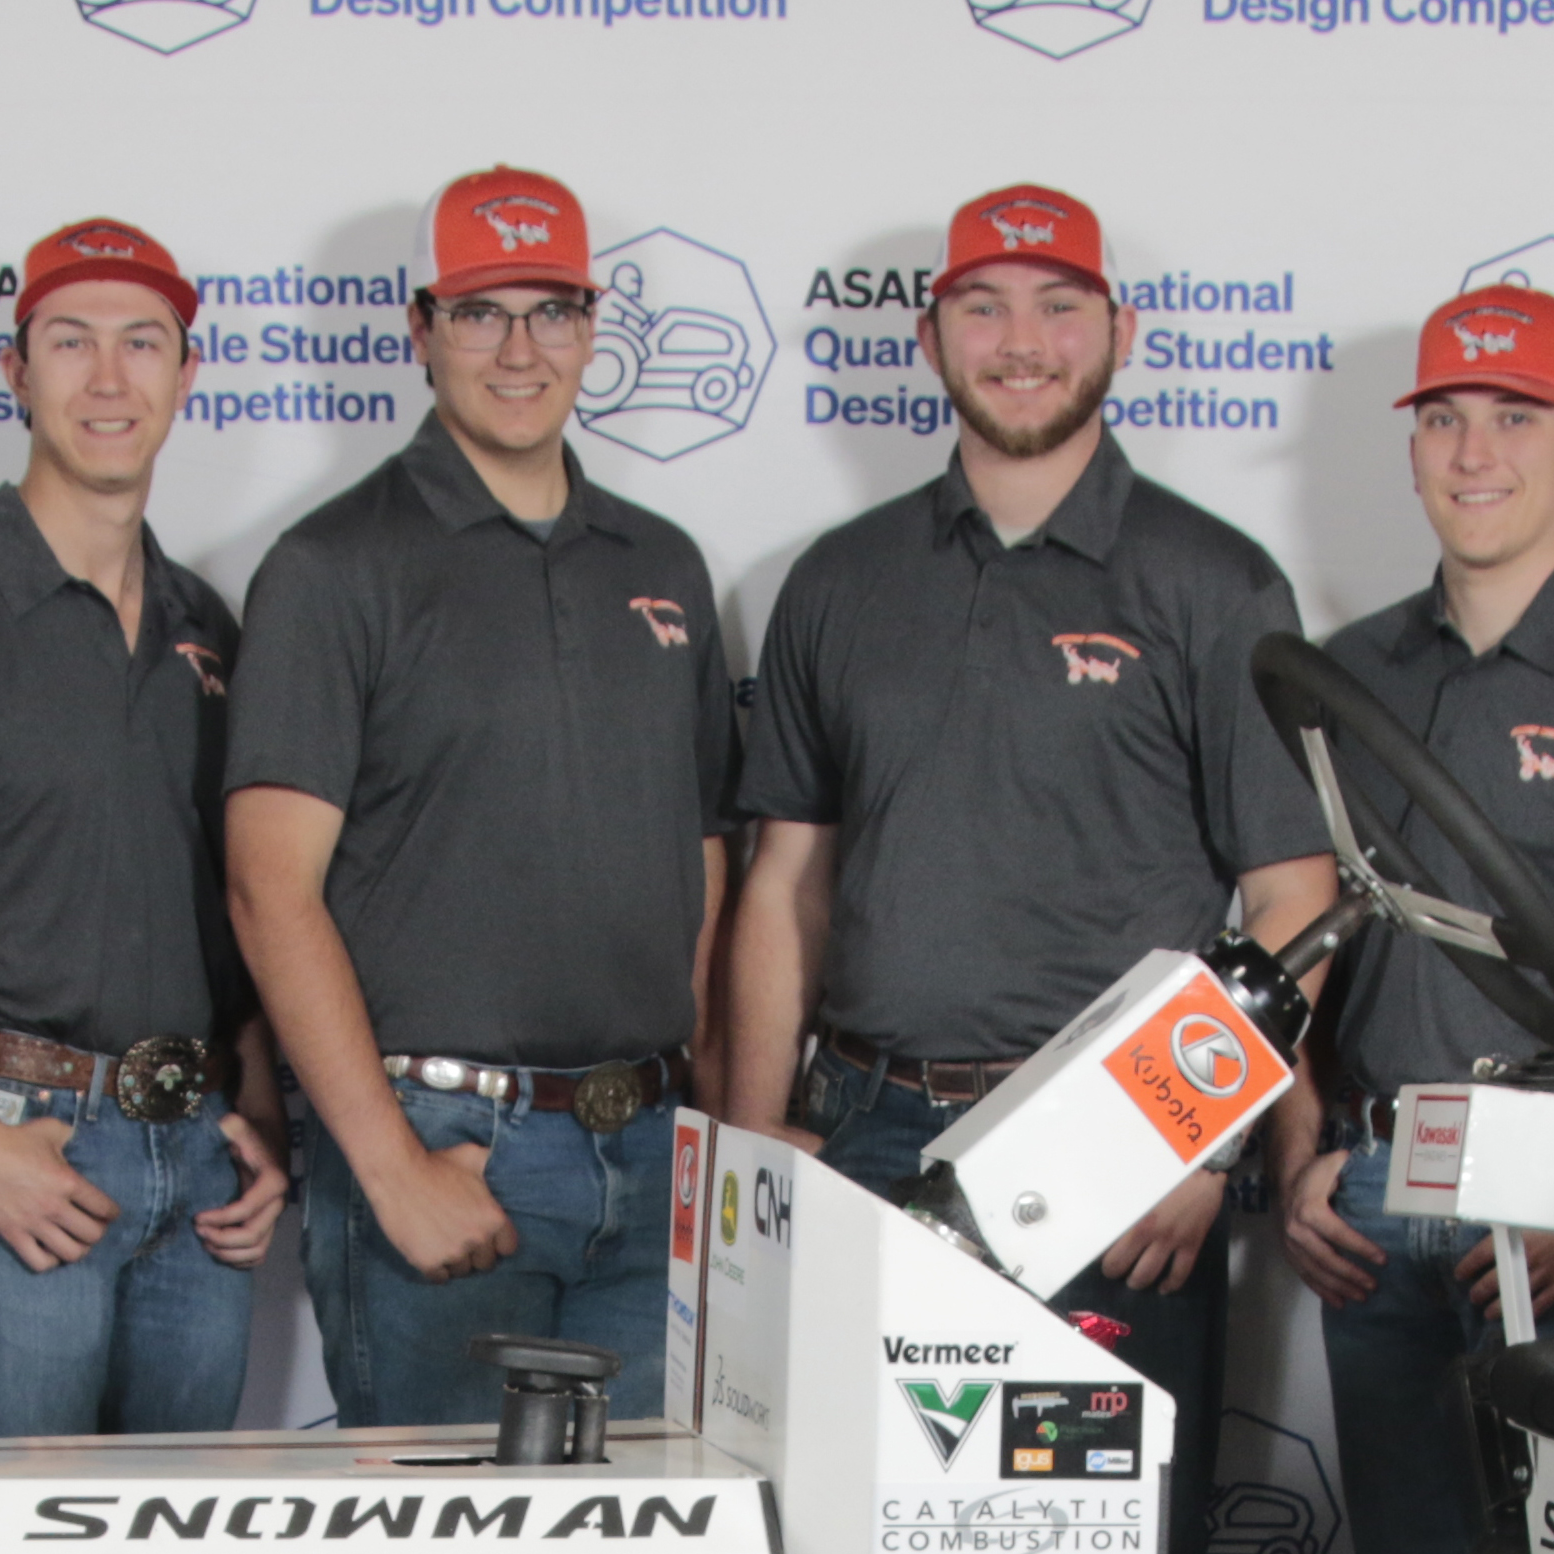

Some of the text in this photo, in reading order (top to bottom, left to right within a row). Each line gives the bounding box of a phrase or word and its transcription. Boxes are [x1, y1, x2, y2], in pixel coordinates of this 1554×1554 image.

[197, 268, 406, 307] rnational
[805, 270, 932, 308] ASAB
[804, 329, 1333, 373] Quar Student
[1102, 390, 1278, 435] petition
[1129, 1040, 1202, 1145] Kubota
[754, 1167, 791, 1248] CNH
[883, 1336, 1017, 1365] Vermeer
[1015, 1451, 1049, 1470] igus
[23, 1495, 717, 1541] SNOWMAN
[882, 1500, 1141, 1521] CATALYTIC
[882, 1530, 1141, 1552] COMBUSTION
